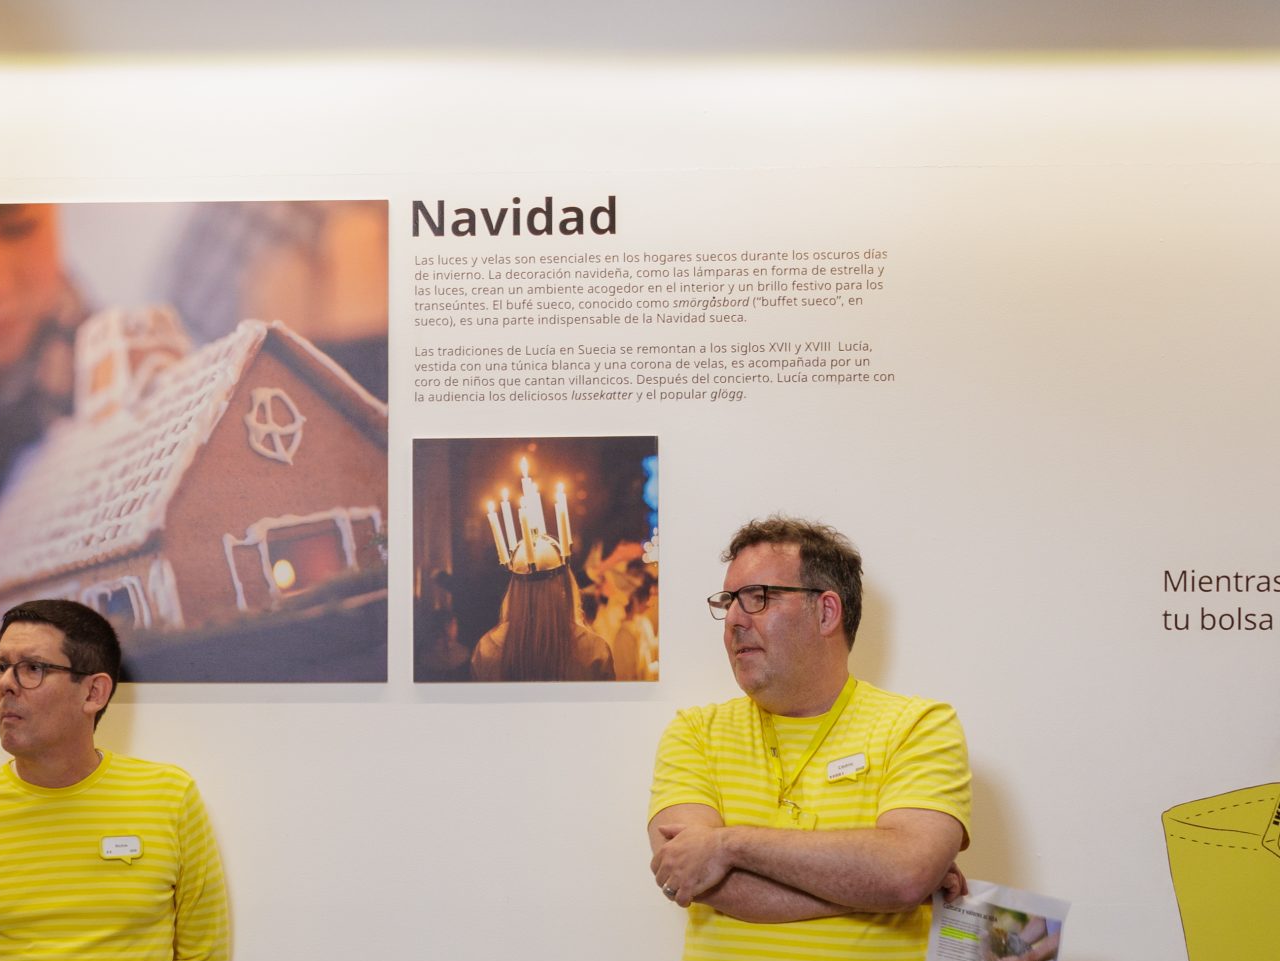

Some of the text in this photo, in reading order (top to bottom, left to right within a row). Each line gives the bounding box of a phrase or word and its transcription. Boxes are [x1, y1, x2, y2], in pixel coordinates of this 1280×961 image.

[412, 195, 616, 237] Navidad
[414, 248, 887, 268] Las luces y velas son esenciales en los hogares suecos durante los oscuros días
[414, 387, 746, 403] la audiencia los deliciosos lussekatter y el popular glögg.
[1164, 569, 1280, 593] Mientras
[1162, 607, 1273, 631] tu bolsa
